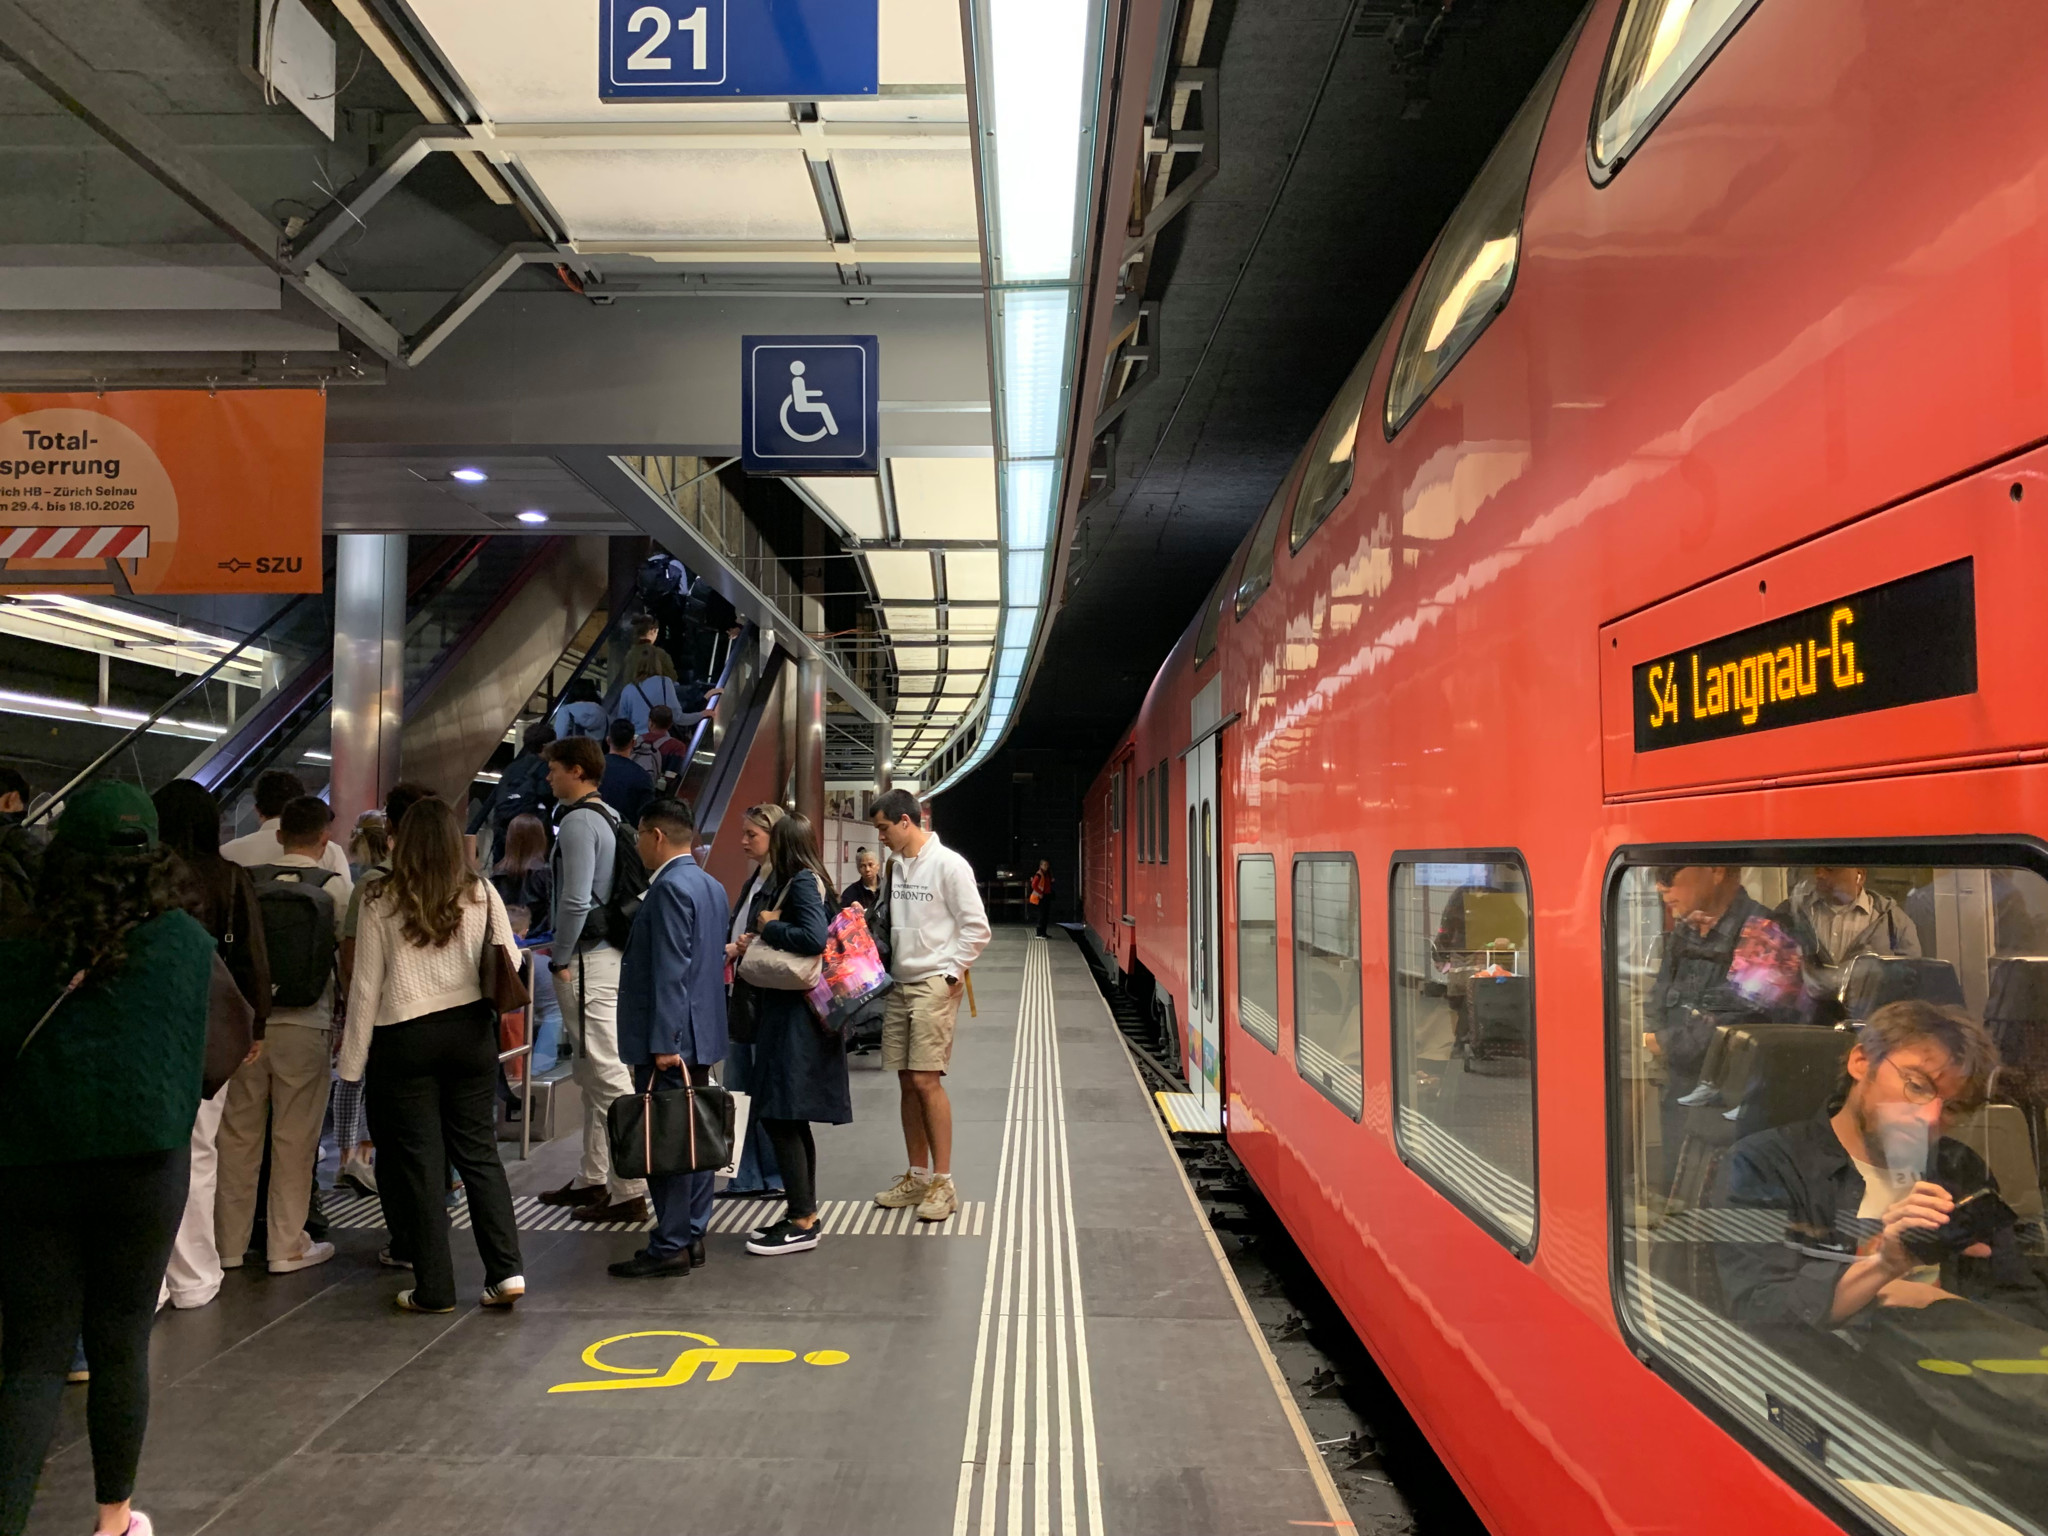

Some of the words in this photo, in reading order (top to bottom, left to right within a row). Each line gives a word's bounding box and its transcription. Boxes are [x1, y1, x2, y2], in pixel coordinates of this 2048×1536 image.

[627, 6, 707, 70] 21
[22, 429, 98, 450] Total-
[0, 459, 120, 479] sperrung
[0, 486, 20, 497] ich
[23, 487, 42, 497] HB
[53, 486, 93, 497] Zürich
[95, 486, 138, 496] Selnau
[11, 501, 43, 511] 29.4.
[46, 501, 66, 511] bis
[69, 500, 135, 511] 18.10.2026
[256, 557, 302, 573] SZU
[1648, 661, 1679, 728] S4
[1692, 607, 1865, 726] Langnau-G.
